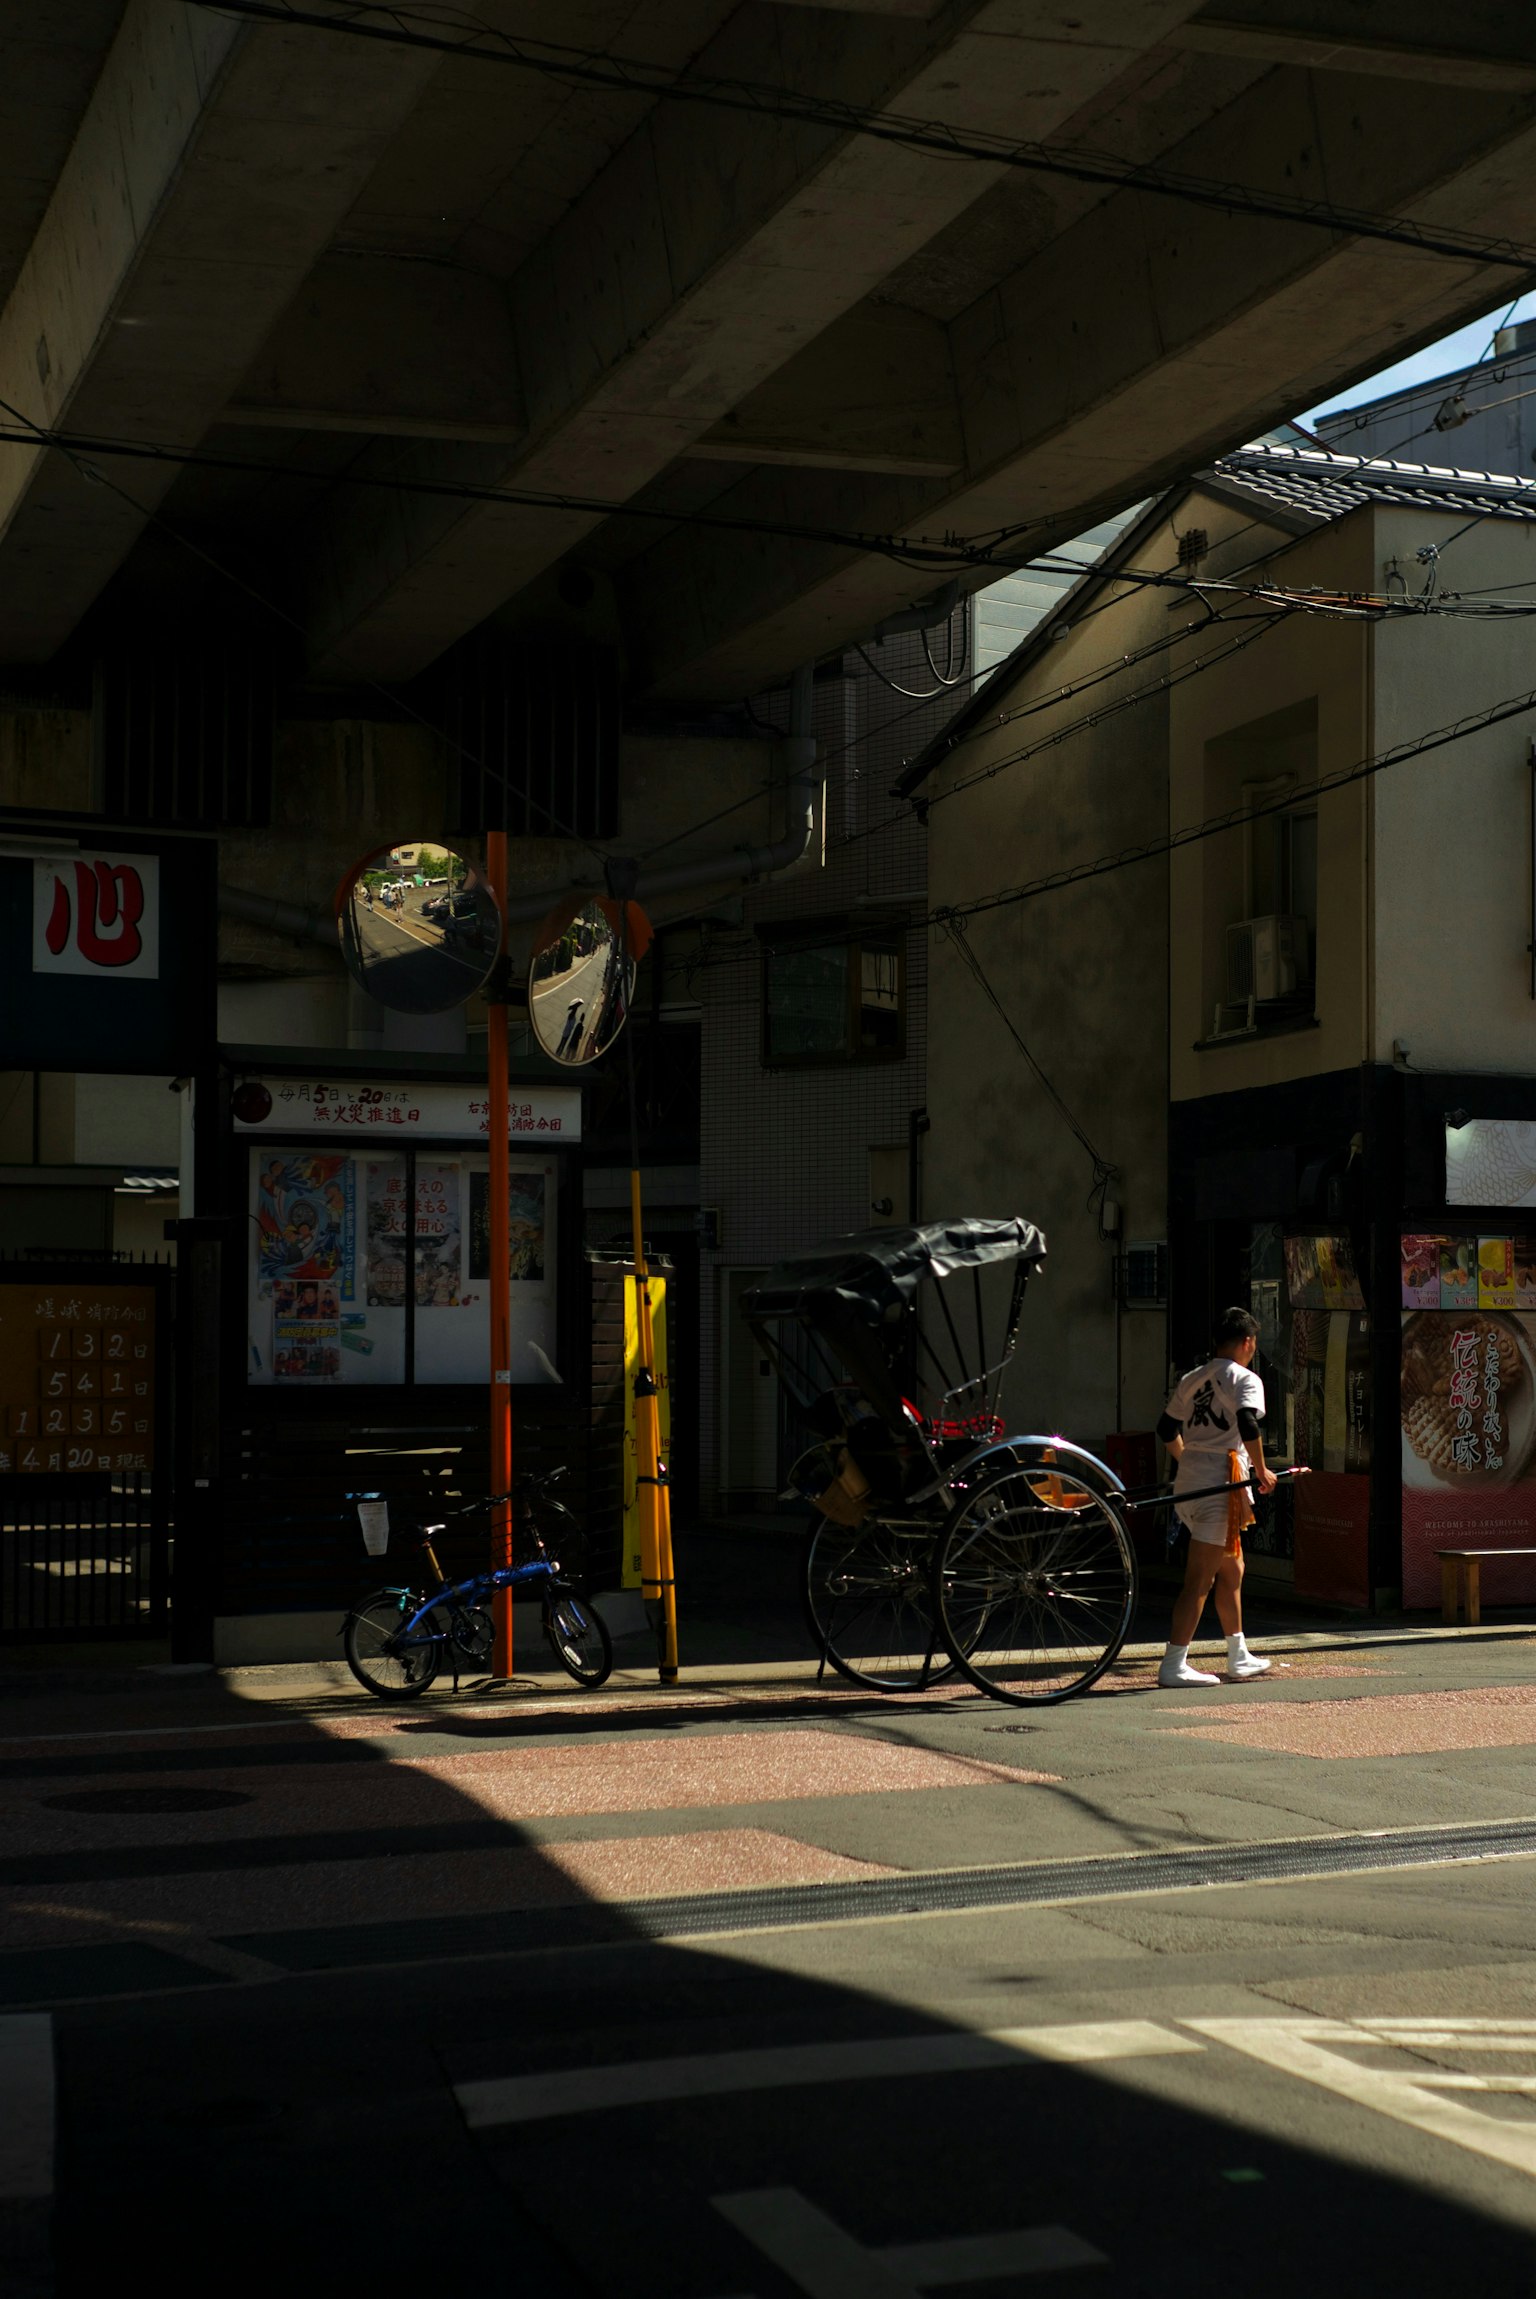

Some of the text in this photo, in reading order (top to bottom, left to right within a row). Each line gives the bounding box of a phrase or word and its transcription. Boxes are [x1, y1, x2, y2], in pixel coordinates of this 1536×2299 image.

[313, 1104, 420, 1125] 無火災推進日
[468, 1101, 532, 1117] 右京防団
[480, 1117, 561, 1133] 嵯消防分団
[383, 1197, 448, 1214] 京をまもる
[35, 1298, 146, 1321] 嵯峨消防分団
[1187, 1379, 1231, 1431] 嵐
[1450, 1330, 1482, 1471] 伝統の味
[1354, 1371, 1365, 1465] チョコレート
[1425, 1519, 1529, 1529] WELCOME TO ARASHIYAMA
